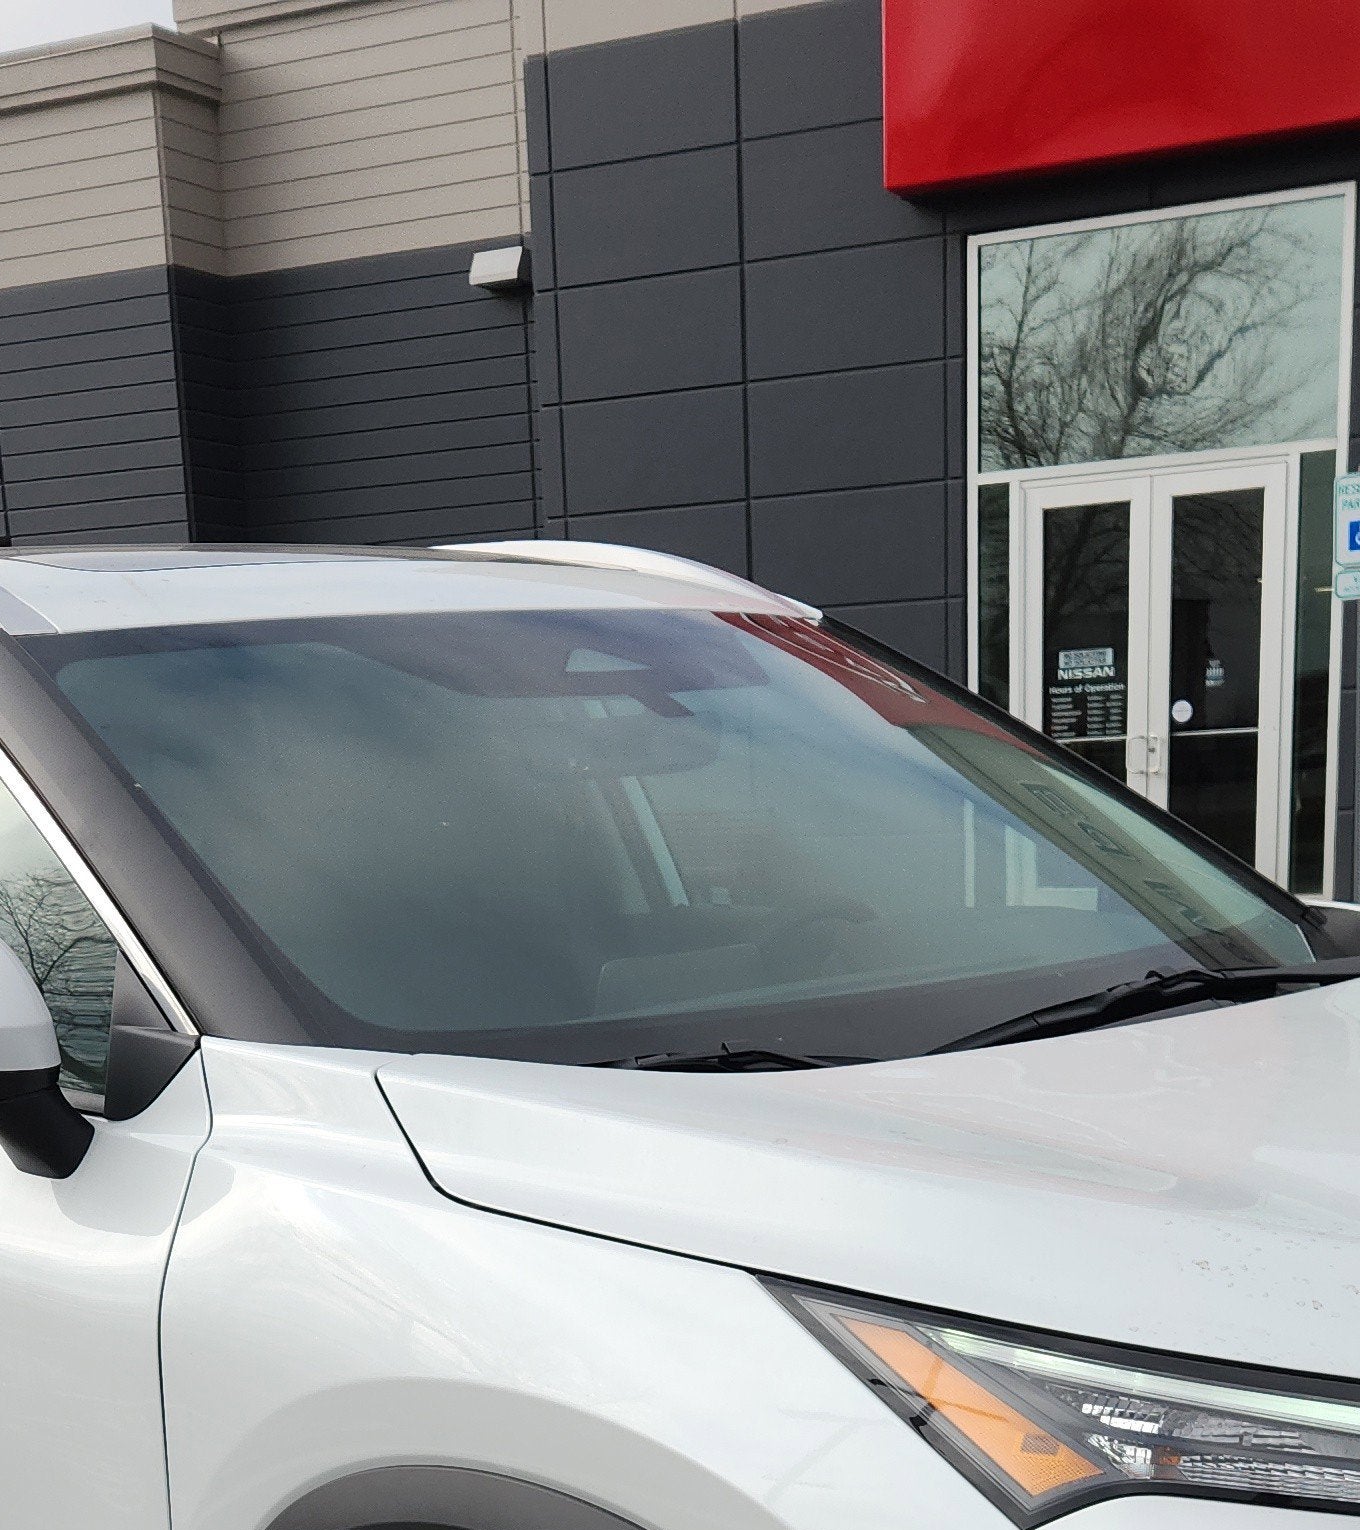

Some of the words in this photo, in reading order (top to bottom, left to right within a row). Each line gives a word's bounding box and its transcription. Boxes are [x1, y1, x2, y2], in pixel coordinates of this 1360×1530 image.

[1057, 666, 1116, 680] NISSAN
[1048, 686, 1073, 694] Hours
[1073, 683, 1083, 693] of
[1084, 682, 1125, 693] Operation
